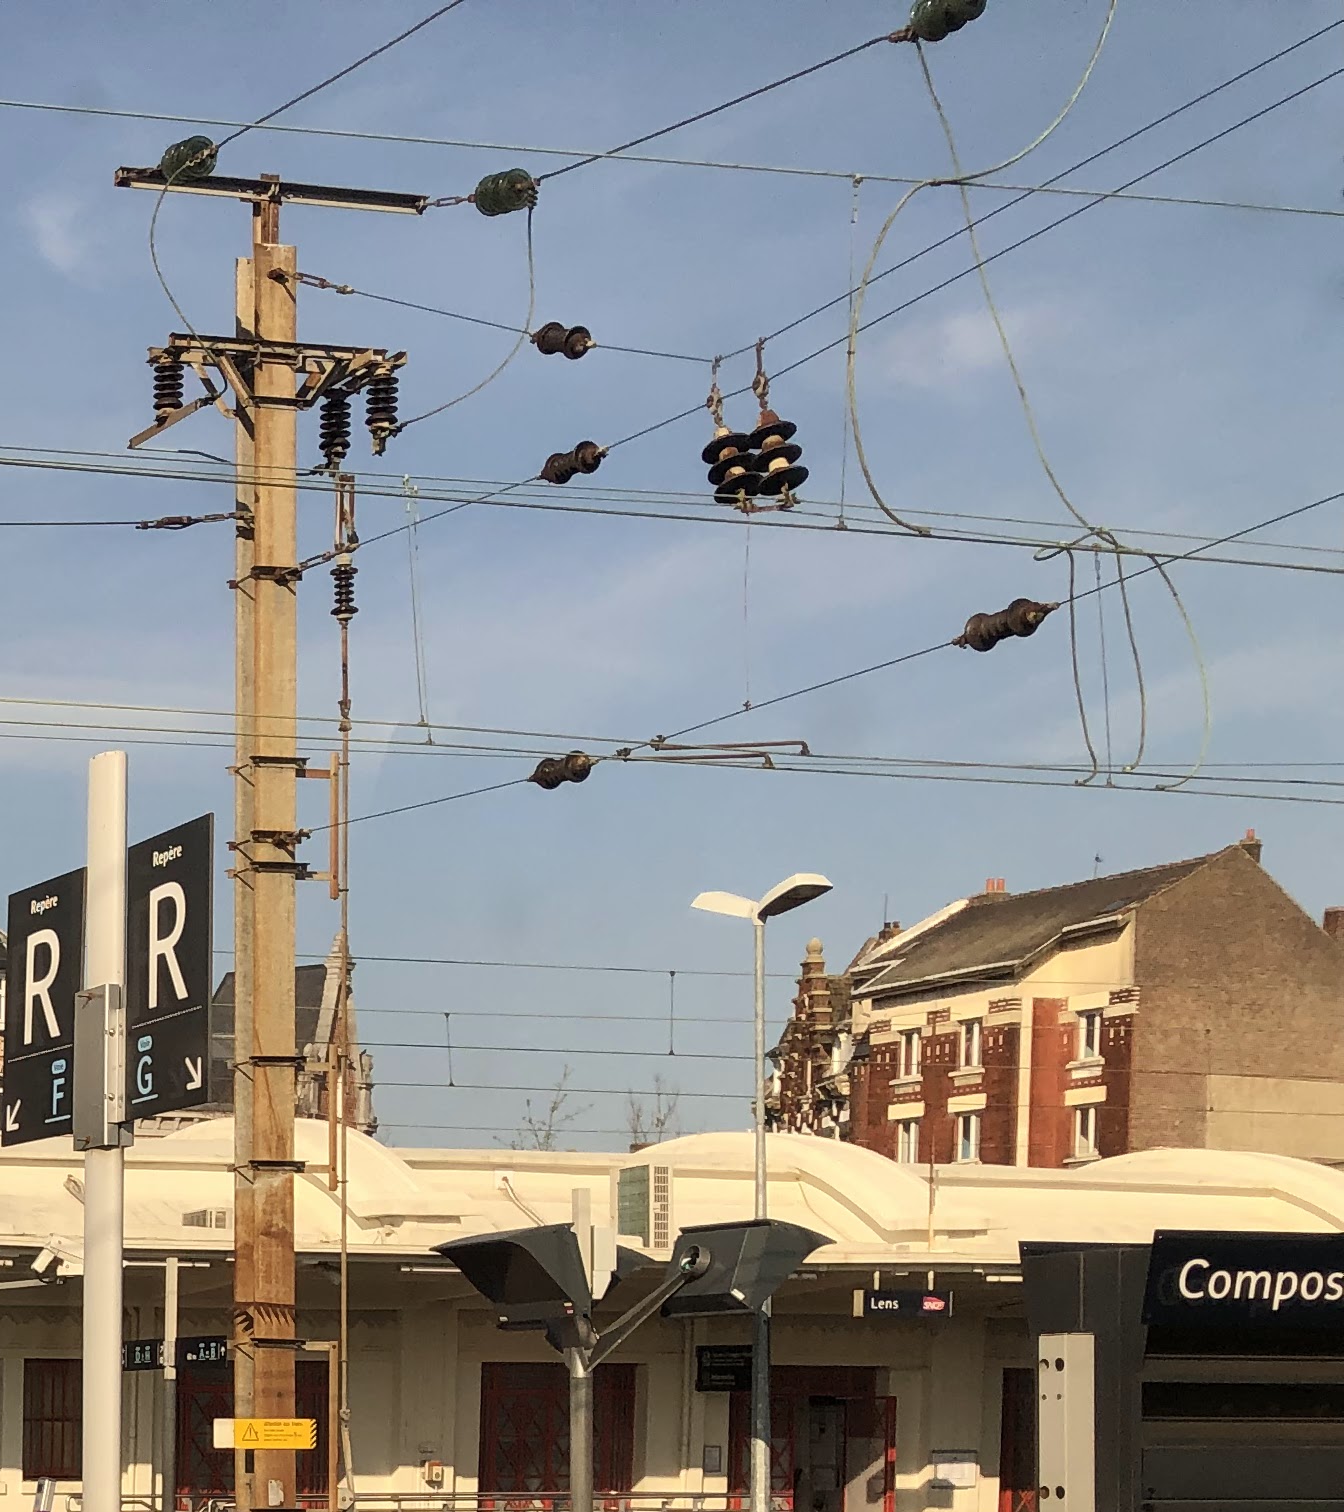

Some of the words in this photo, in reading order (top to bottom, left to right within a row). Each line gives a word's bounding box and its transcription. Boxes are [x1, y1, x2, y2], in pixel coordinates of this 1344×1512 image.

[152, 844, 183, 868] Repère
[30, 895, 59, 915] Repère
[148, 881, 189, 1010] R
[23, 928, 62, 1046] R
[136, 1055, 153, 1095] G
[52, 1077, 66, 1116] F
[870, 1297, 899, 1310] Lens
[1178, 1258, 1344, 1311] Compos
